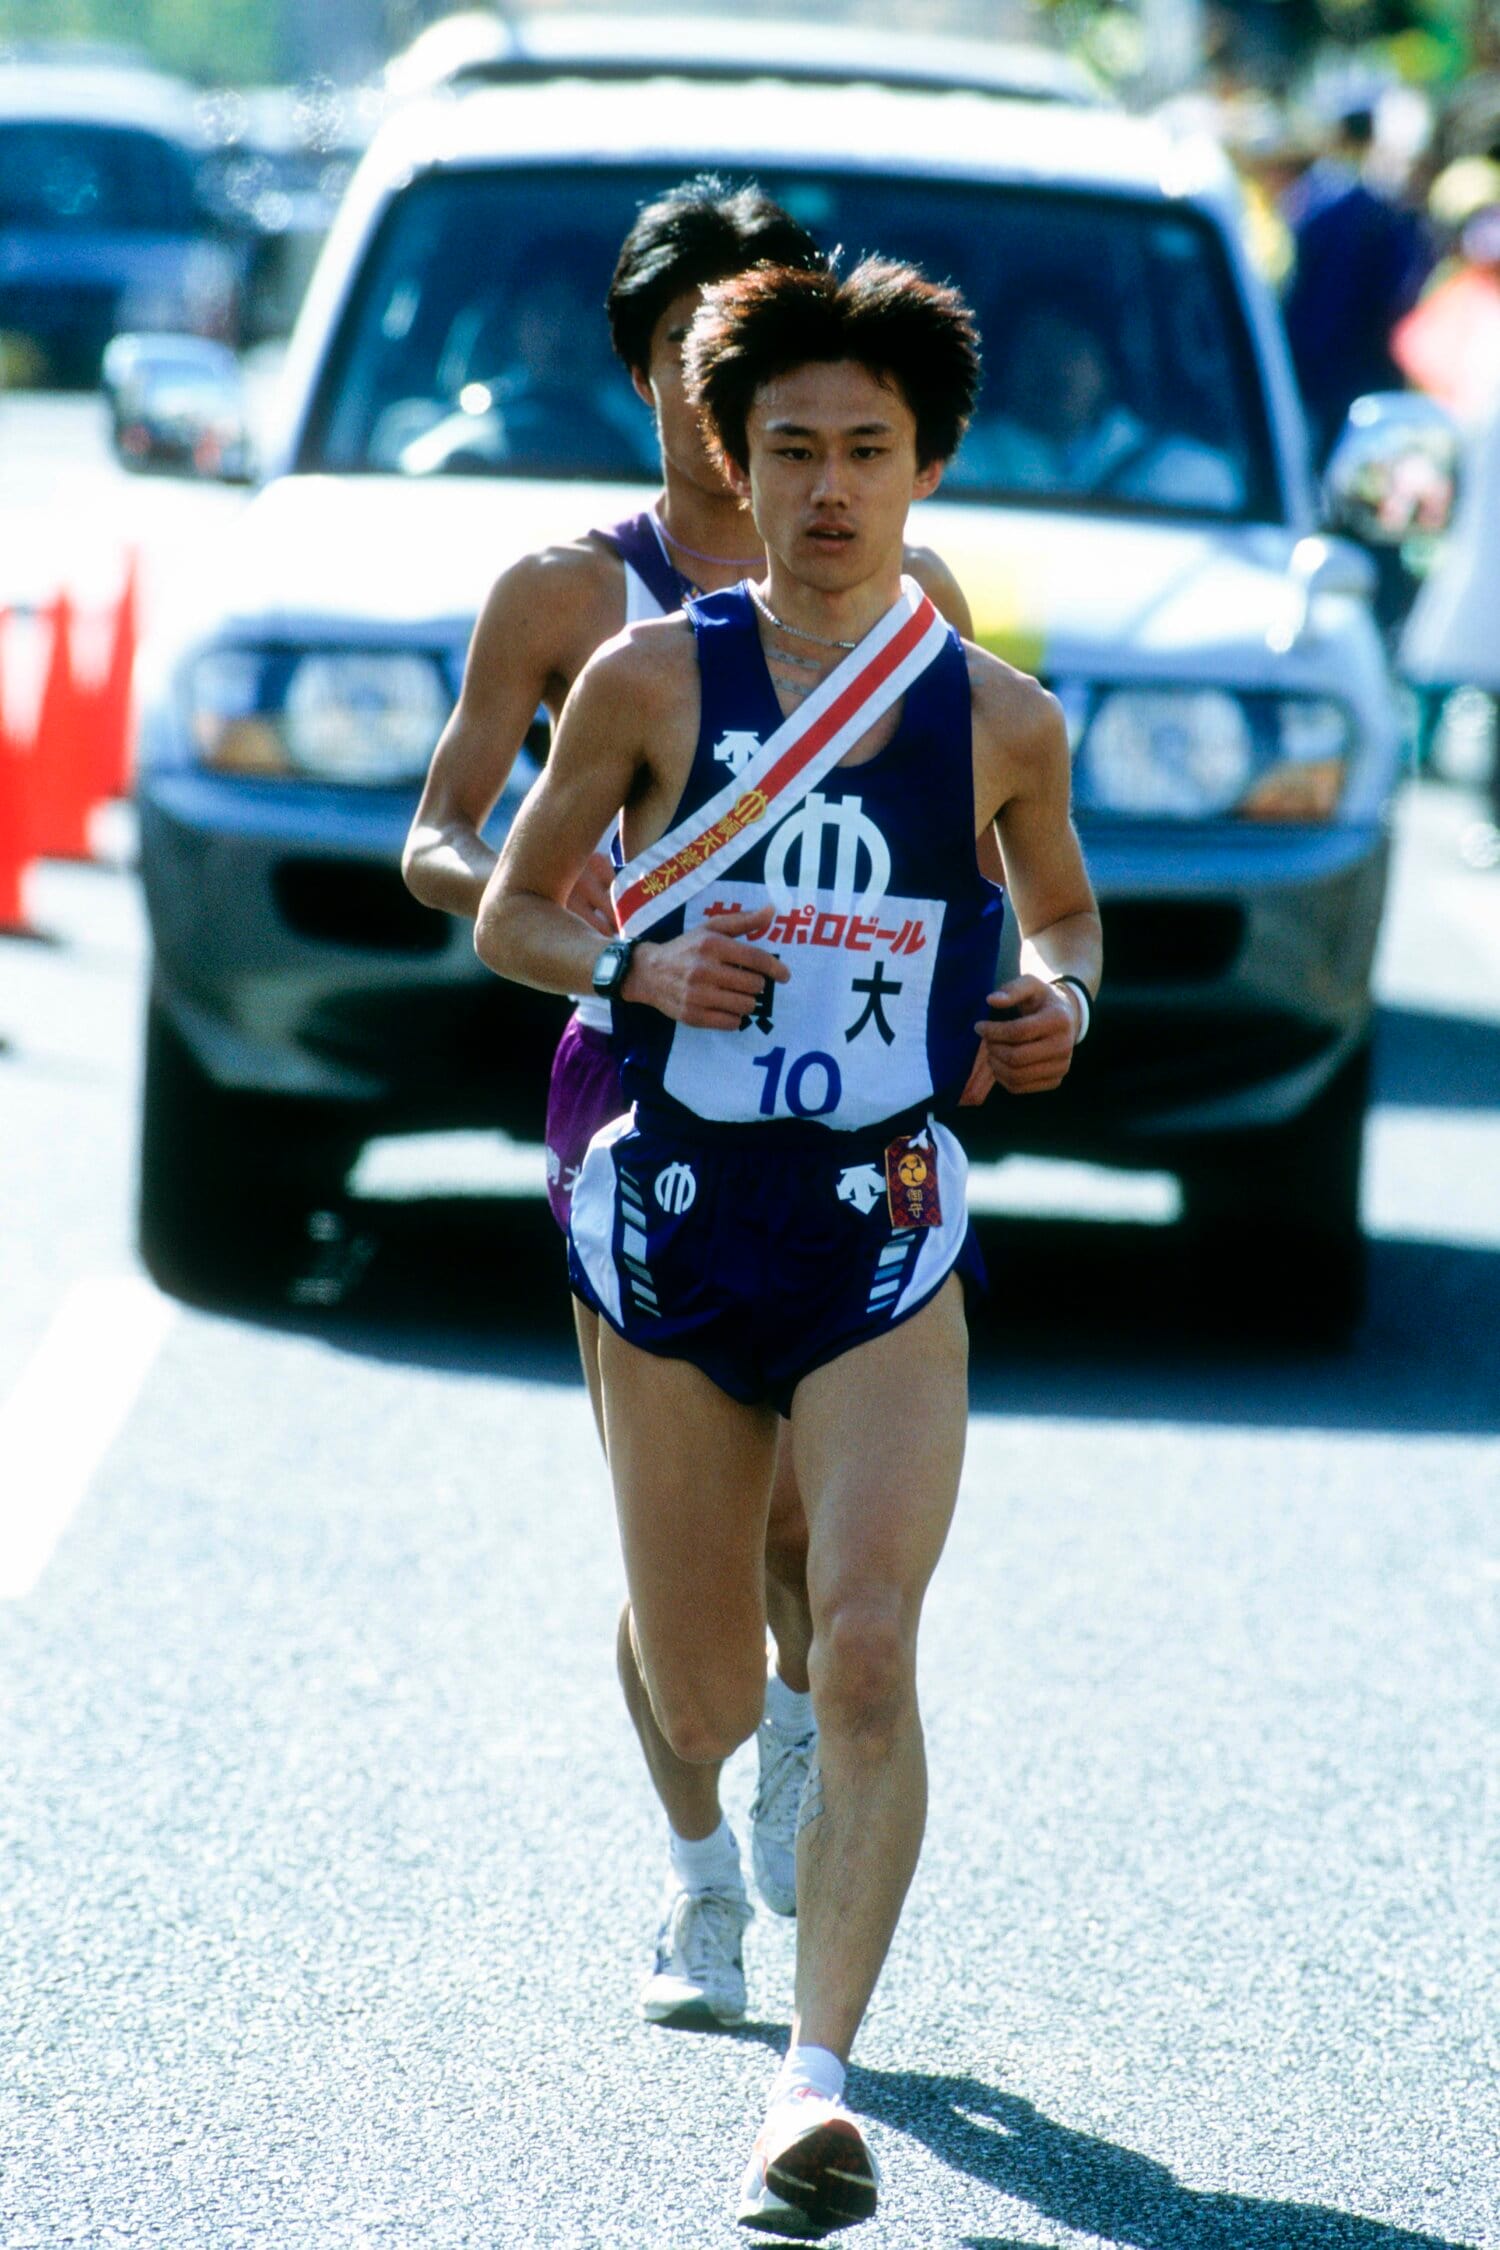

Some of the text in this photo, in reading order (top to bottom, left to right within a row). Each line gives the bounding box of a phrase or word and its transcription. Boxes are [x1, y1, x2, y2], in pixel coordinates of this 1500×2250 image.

[703, 901, 927, 956] サポロビール
[752, 1046, 843, 1117] 10
